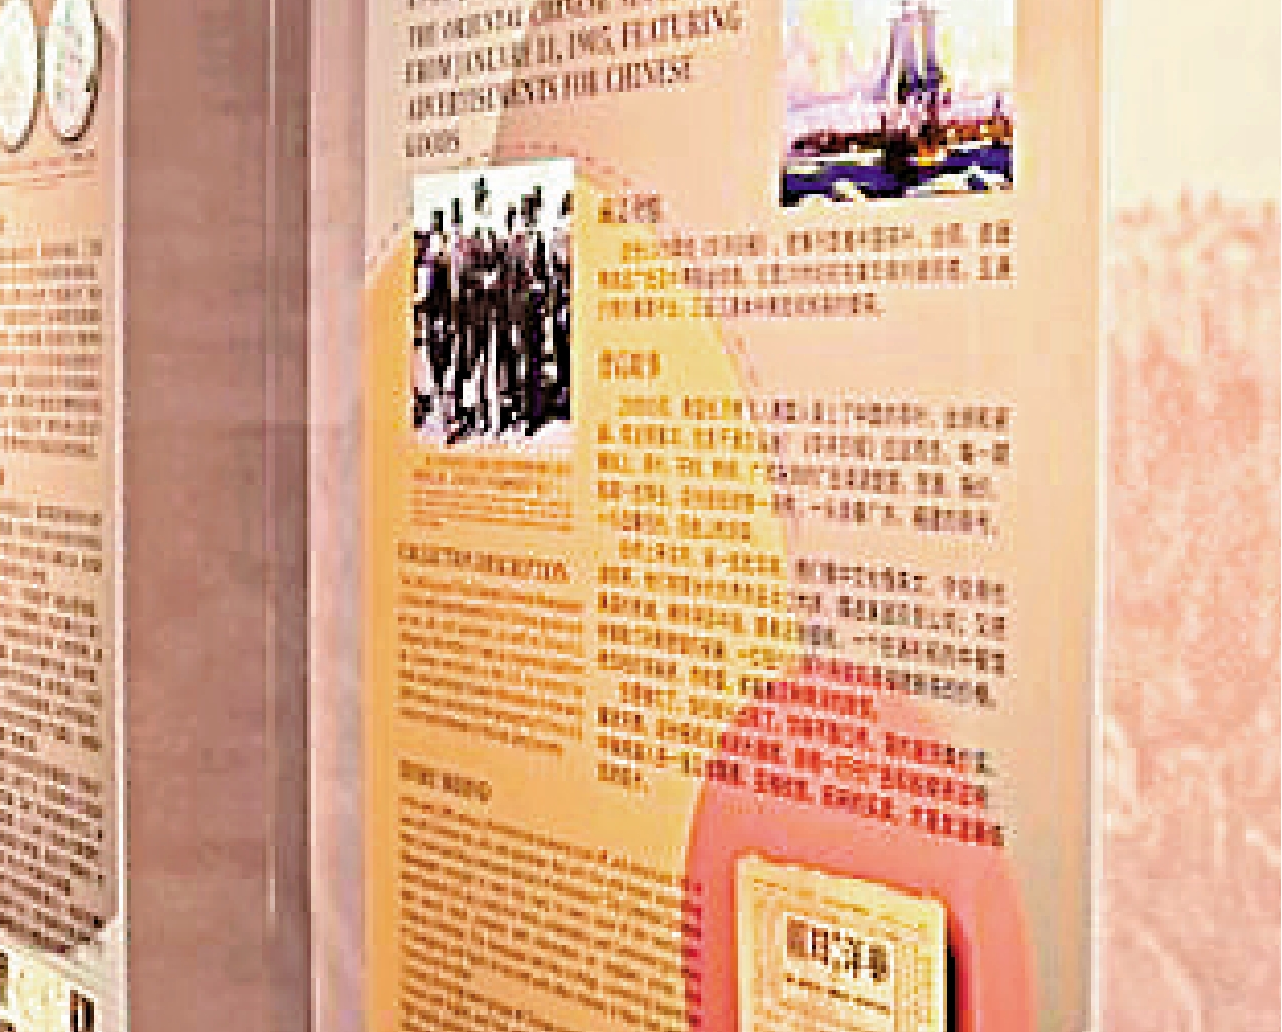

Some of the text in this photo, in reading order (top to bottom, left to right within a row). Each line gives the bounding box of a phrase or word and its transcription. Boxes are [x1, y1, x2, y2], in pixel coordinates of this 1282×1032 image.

[408, 55, 692, 120] ADVERTISEMENTS FOR CHINESE
